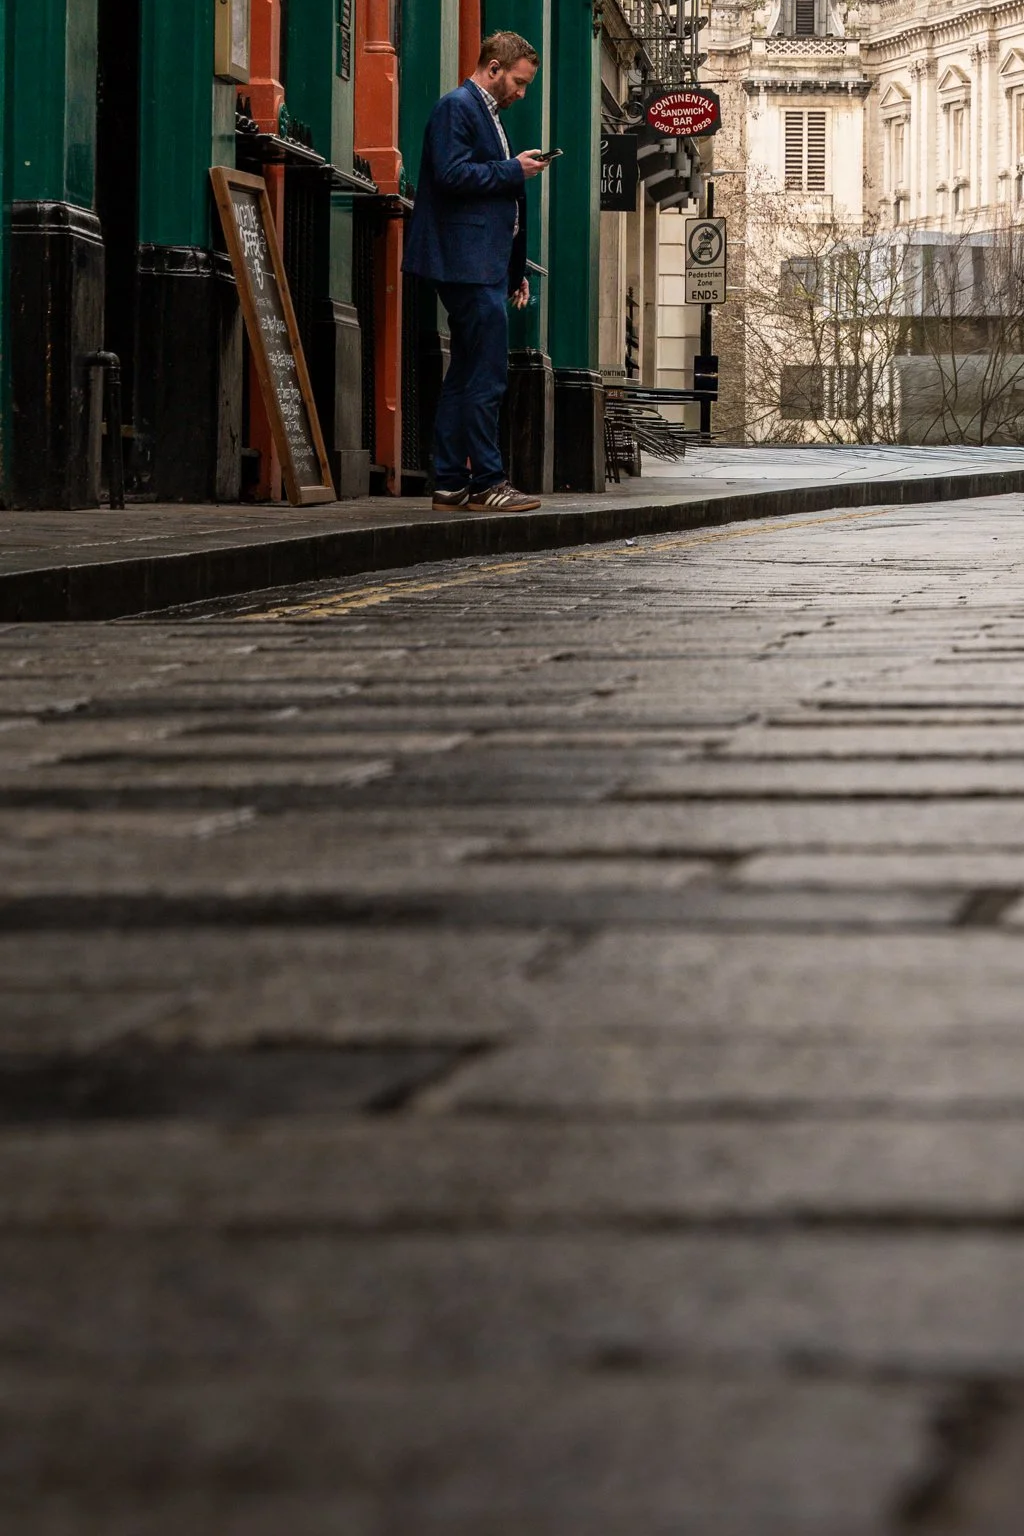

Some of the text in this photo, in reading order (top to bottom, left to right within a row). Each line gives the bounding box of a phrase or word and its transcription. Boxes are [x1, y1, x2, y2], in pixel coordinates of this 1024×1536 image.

[650, 94, 714, 116] CONTINENTAL
[660, 107, 705, 117] SANDWICH
[654, 117, 712, 135] 0207 329 0929
[673, 117, 693, 126] BAR
[688, 271, 722, 279] Pedestrian
[691, 290, 718, 300] ENDS
